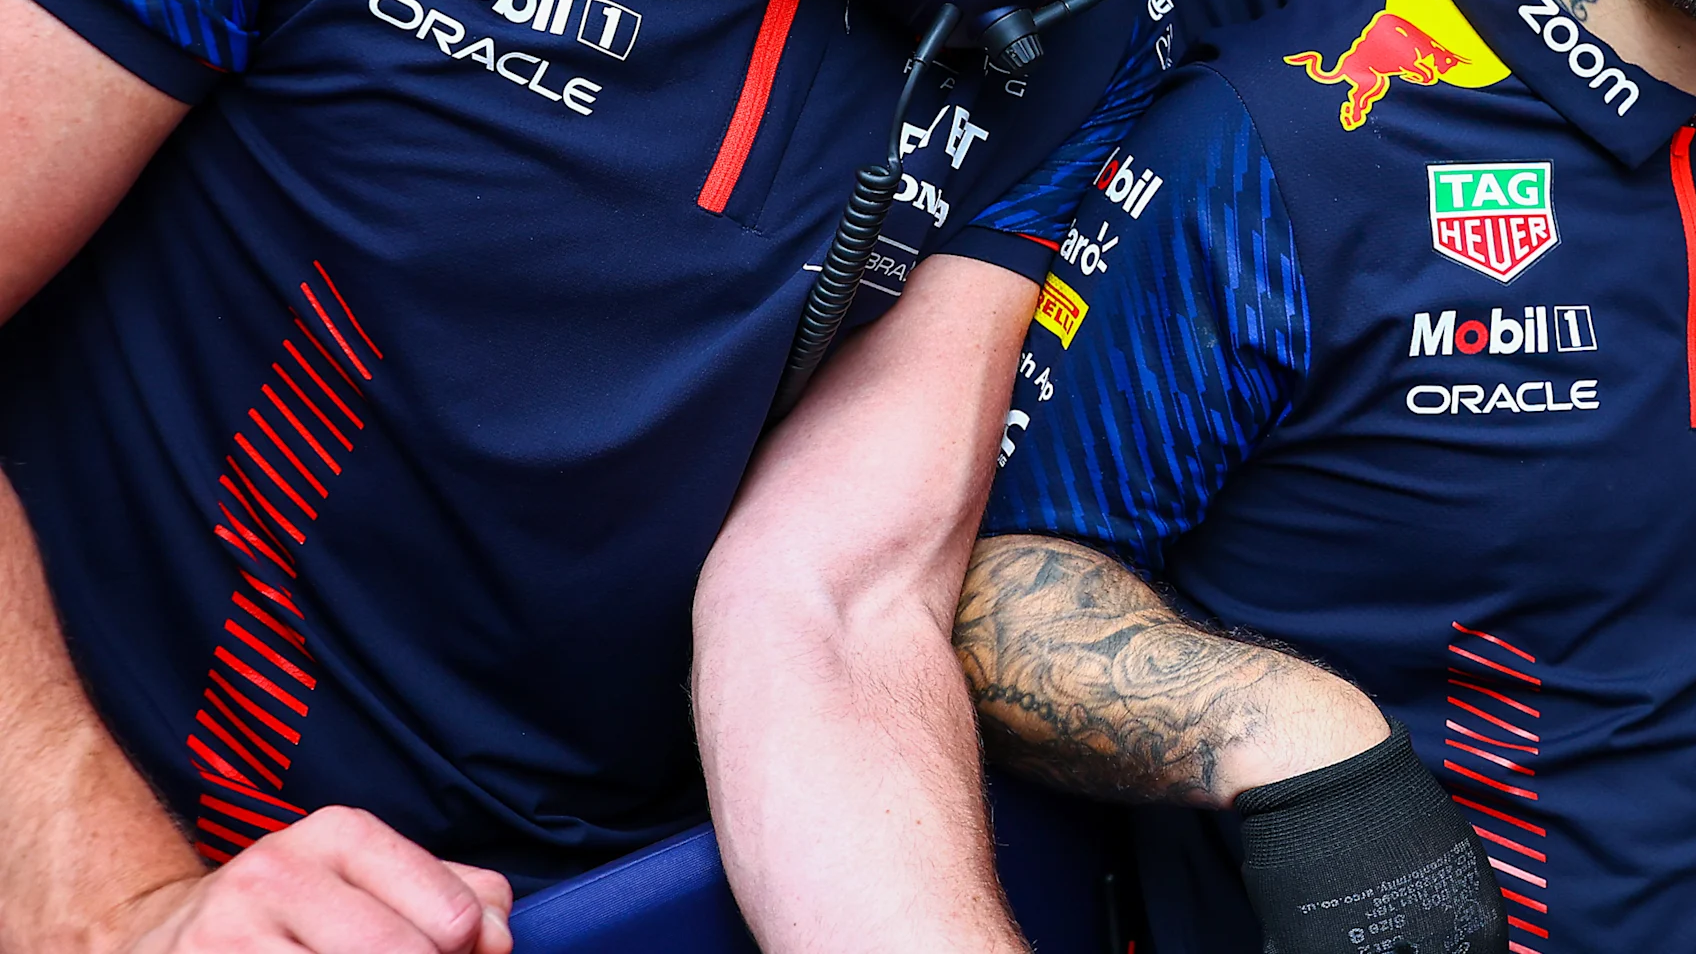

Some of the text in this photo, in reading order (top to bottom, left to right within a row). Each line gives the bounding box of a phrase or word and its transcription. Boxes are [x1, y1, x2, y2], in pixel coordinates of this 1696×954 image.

[1093, 147, 1164, 220] obil
[1438, 172, 1539, 208] TAG
[1440, 215, 1549, 273] HEUER
[1408, 307, 1549, 358] Mobil
[1406, 379, 1600, 415] ORACLE
